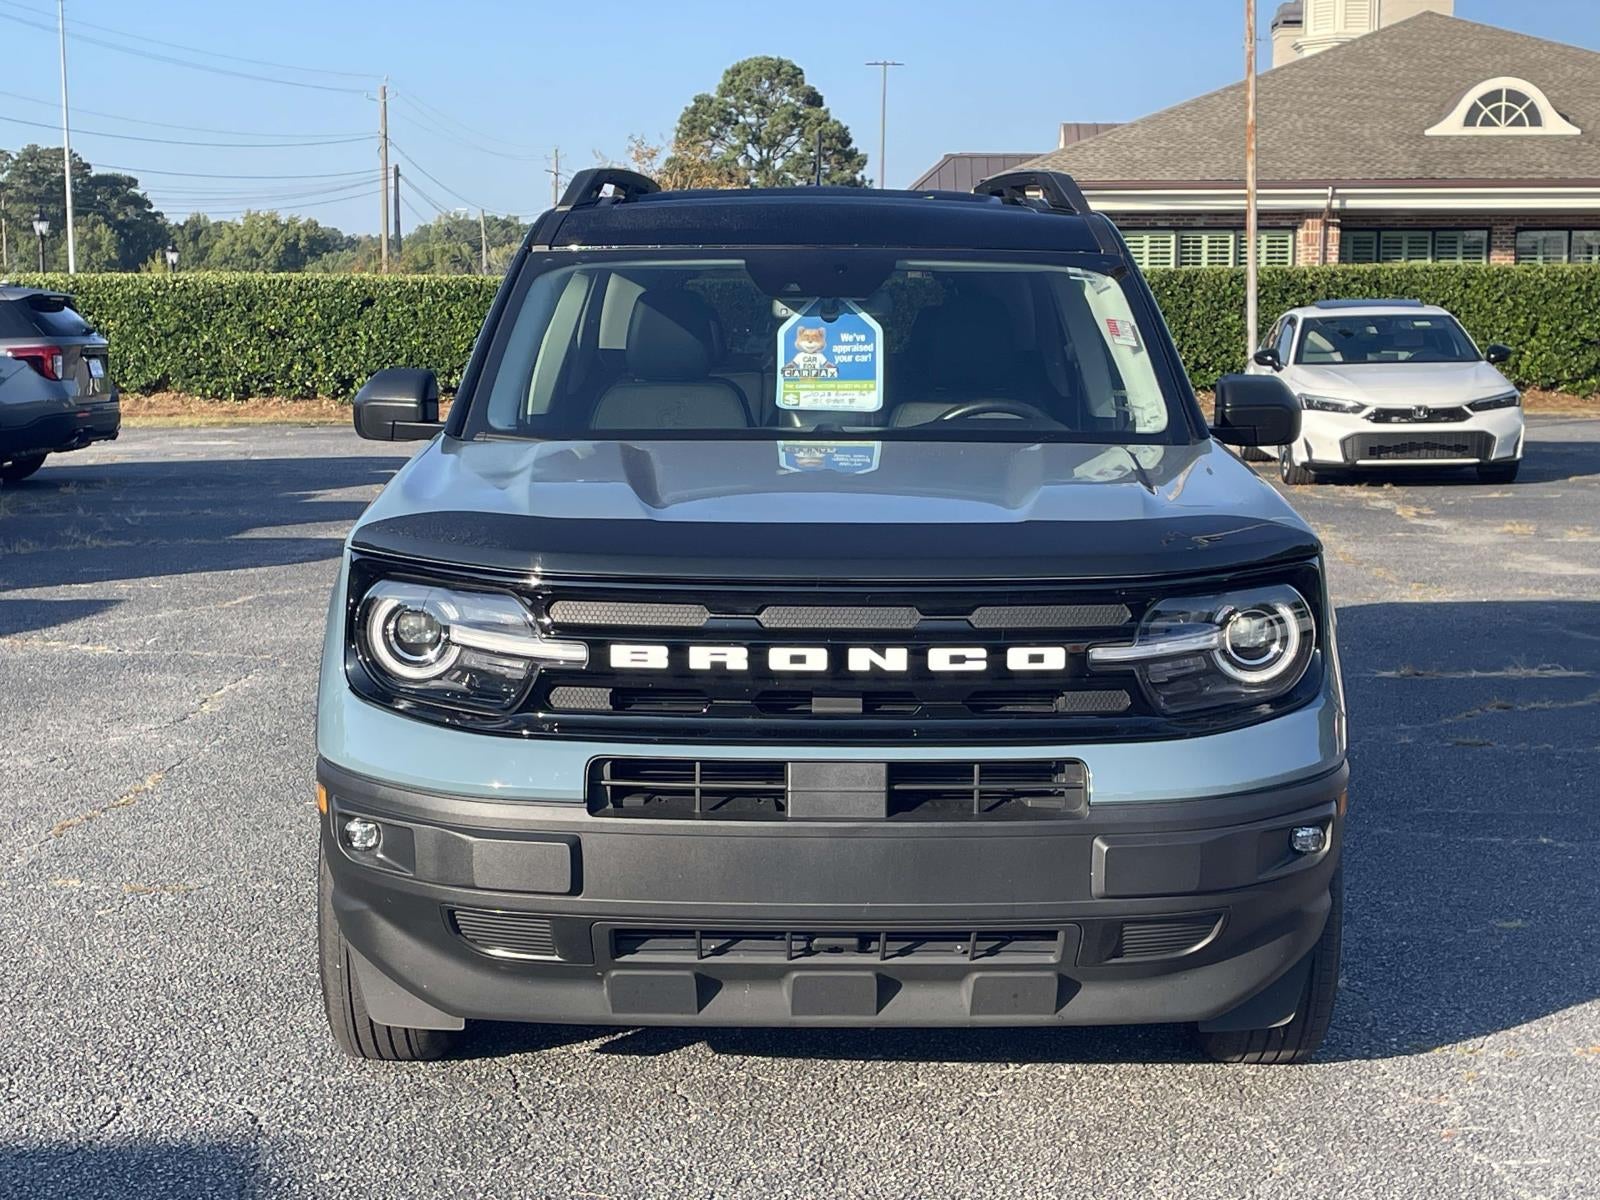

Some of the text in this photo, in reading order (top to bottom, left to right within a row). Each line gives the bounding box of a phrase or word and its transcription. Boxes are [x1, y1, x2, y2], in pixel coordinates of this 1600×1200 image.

[840, 333, 866, 342] We've
[832, 343, 874, 353] appraised
[834, 354, 872, 364] your car!
[784, 369, 838, 378] CARFAX
[610, 645, 1066, 671] BRONCO
